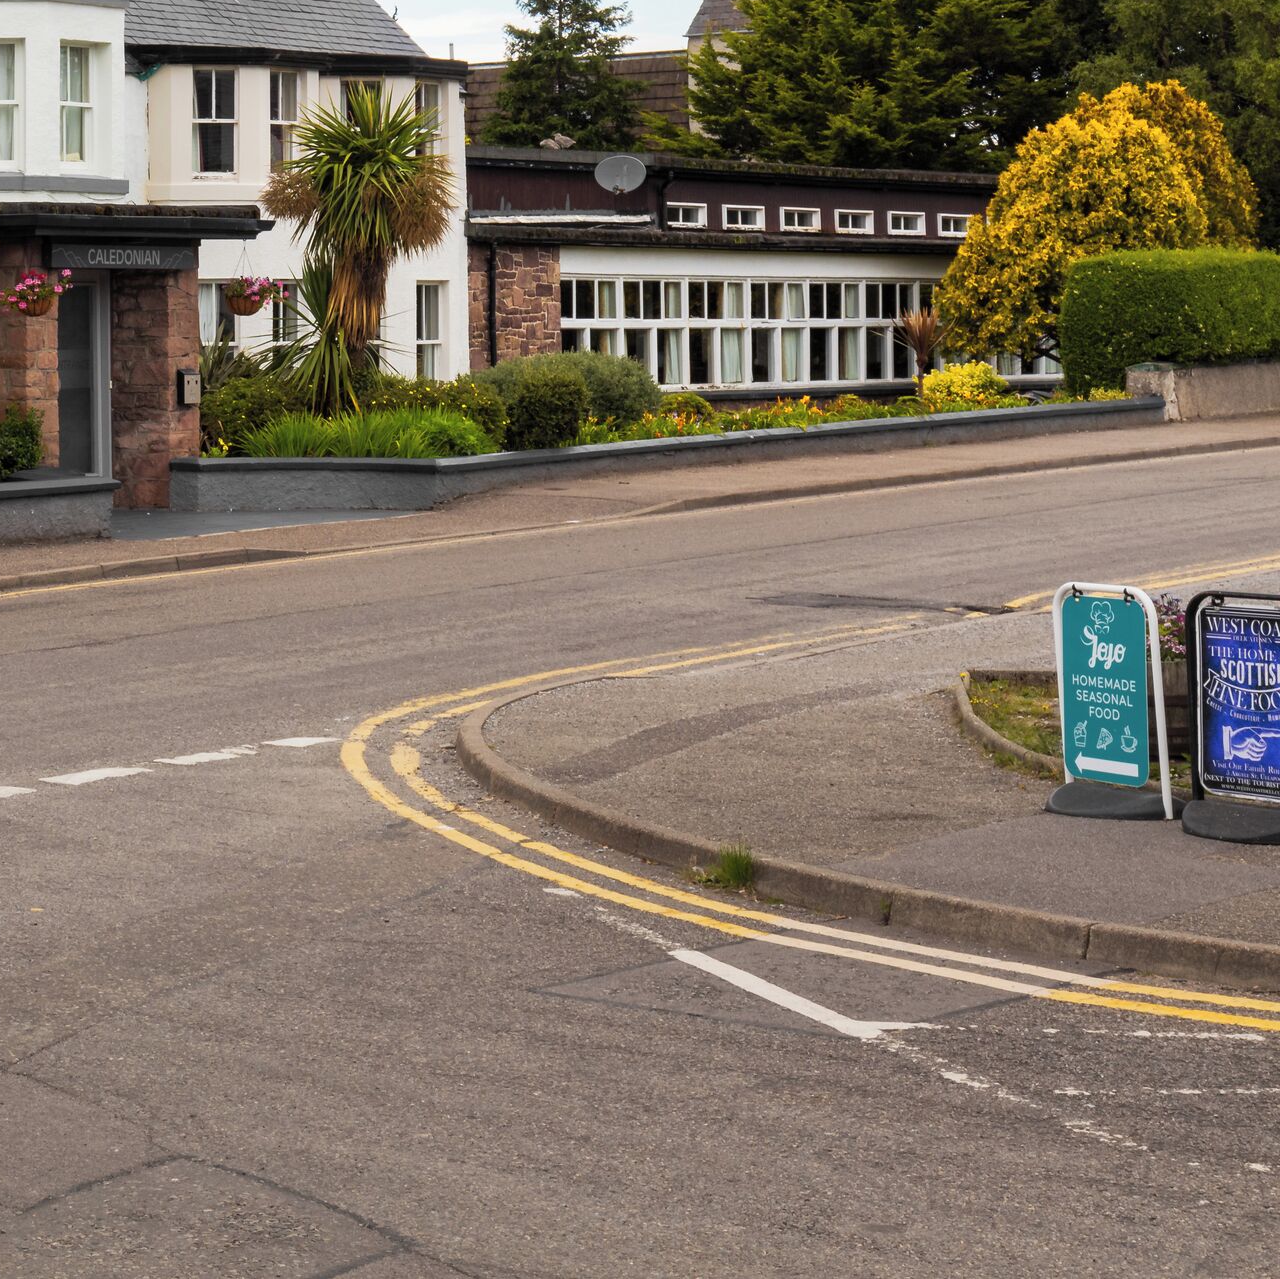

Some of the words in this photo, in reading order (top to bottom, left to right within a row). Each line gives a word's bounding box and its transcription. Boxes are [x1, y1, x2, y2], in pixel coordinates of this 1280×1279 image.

[88, 248, 160, 266] CALEDONIAN
[1207, 616, 1248, 635] WEST
[1080, 625, 1127, 670] Jojo
[1207, 645, 1235, 658] THE
[1238, 648, 1278, 662] HOME
[1072, 674, 1137, 692] HOMEMADE
[1076, 690, 1134, 707] SEASONAL
[1210, 679, 1247, 710] FINE
[1089, 706, 1121, 721] FOOD
[1204, 773, 1224, 782] (NEXT
[1225, 776, 1236, 784] TO
[1237, 777, 1251, 786] THE
[1252, 779, 1280, 789] TOURIST
